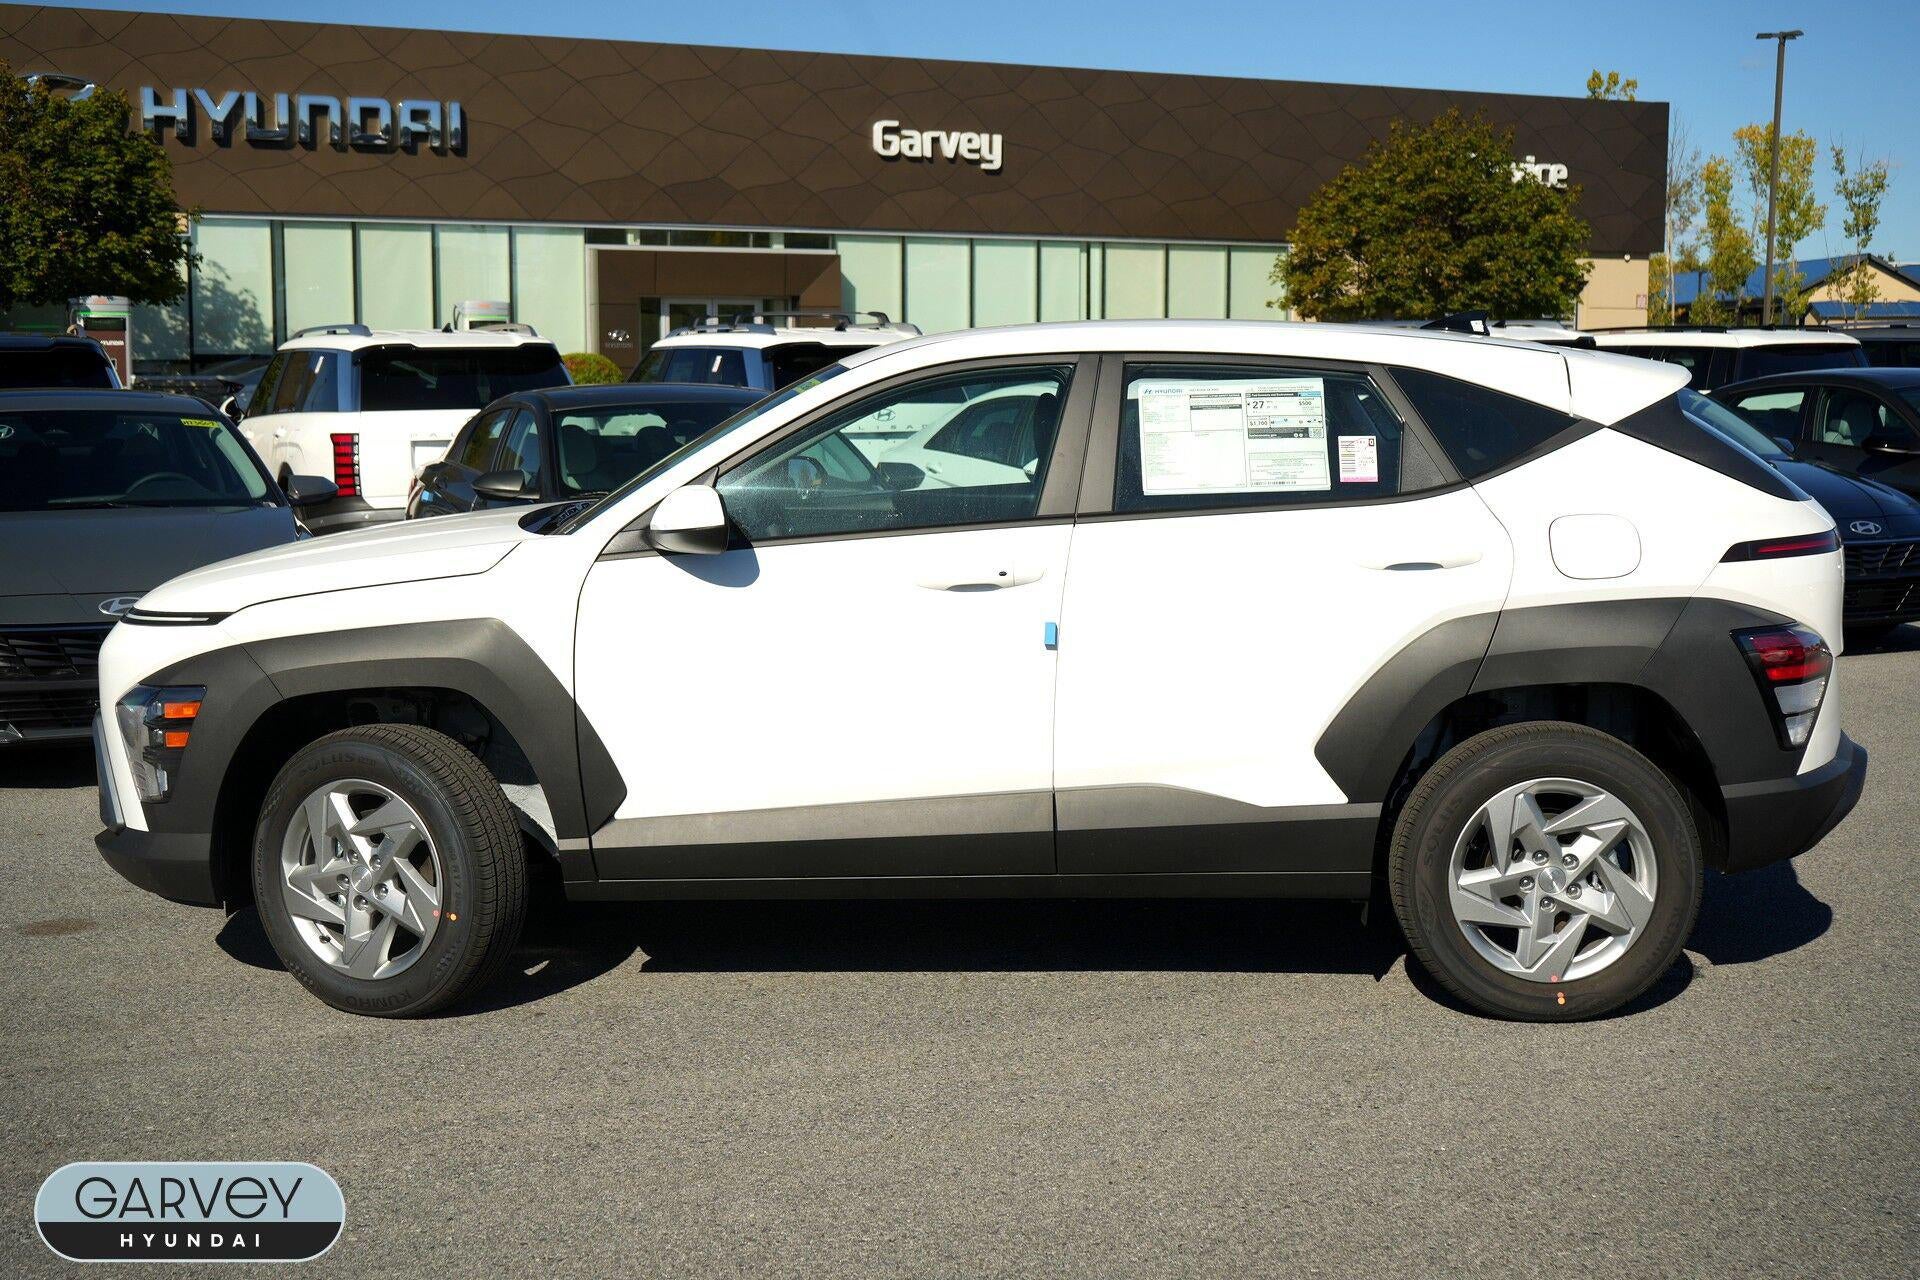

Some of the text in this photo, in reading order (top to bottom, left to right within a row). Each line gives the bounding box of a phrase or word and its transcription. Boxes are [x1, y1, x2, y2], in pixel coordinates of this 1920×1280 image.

[140, 86, 464, 151] HYUNDAI
[872, 120, 1003, 171] Garvey
[1252, 400, 1265, 409] 27
